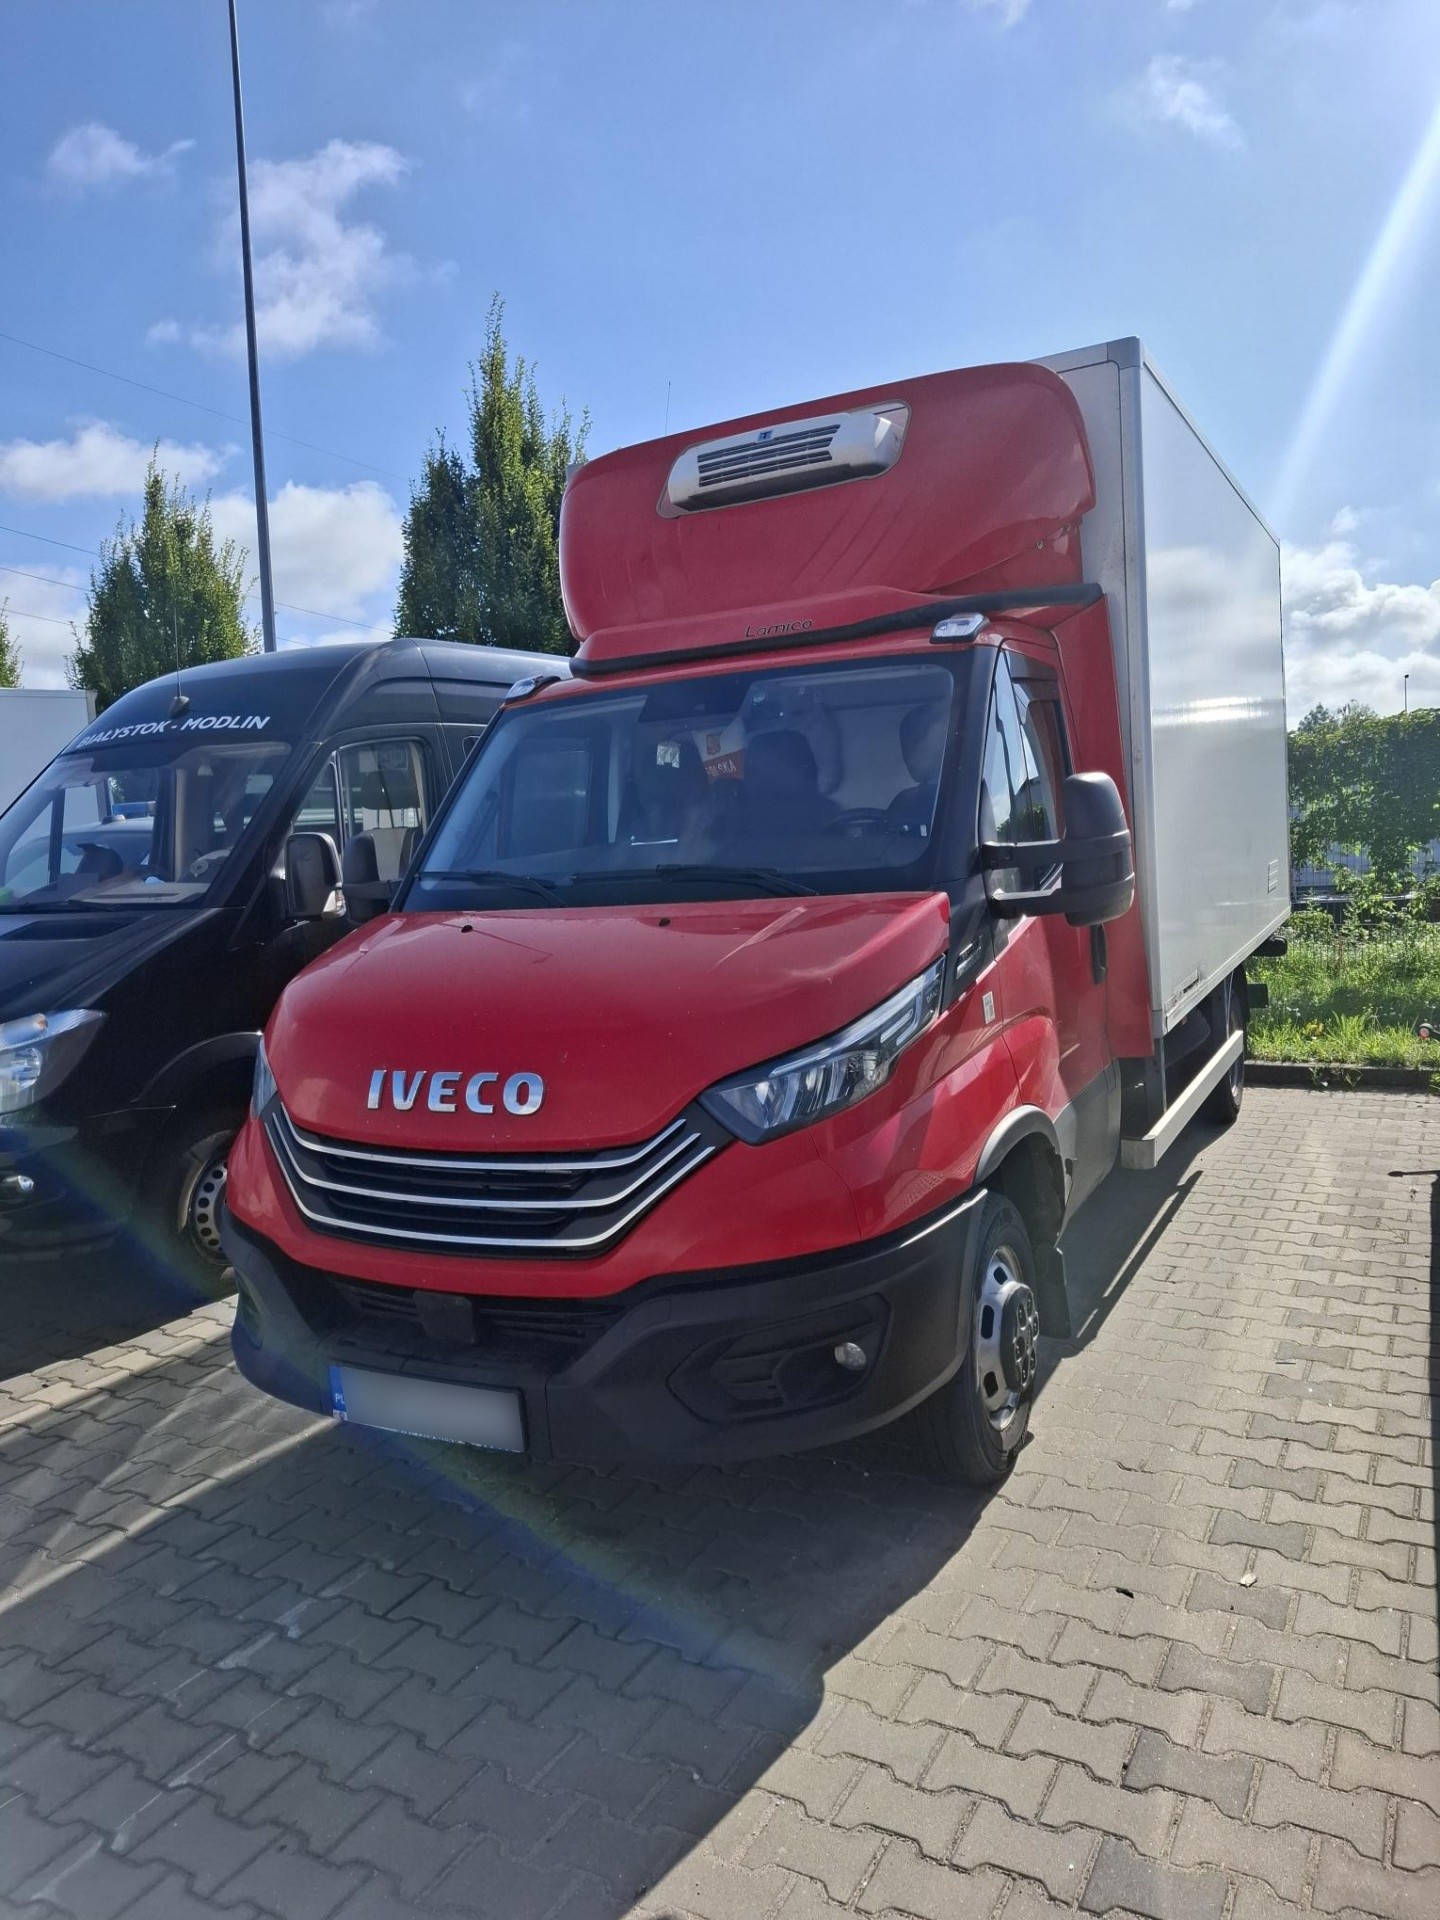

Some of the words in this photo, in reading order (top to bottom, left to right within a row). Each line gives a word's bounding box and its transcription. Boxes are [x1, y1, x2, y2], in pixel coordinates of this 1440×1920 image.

[745, 620, 813, 638] Lamico
[180, 715, 270, 731] MODLIN
[367, 1069, 545, 1116] IVECO
[335, 1393, 346, 1404] PL
